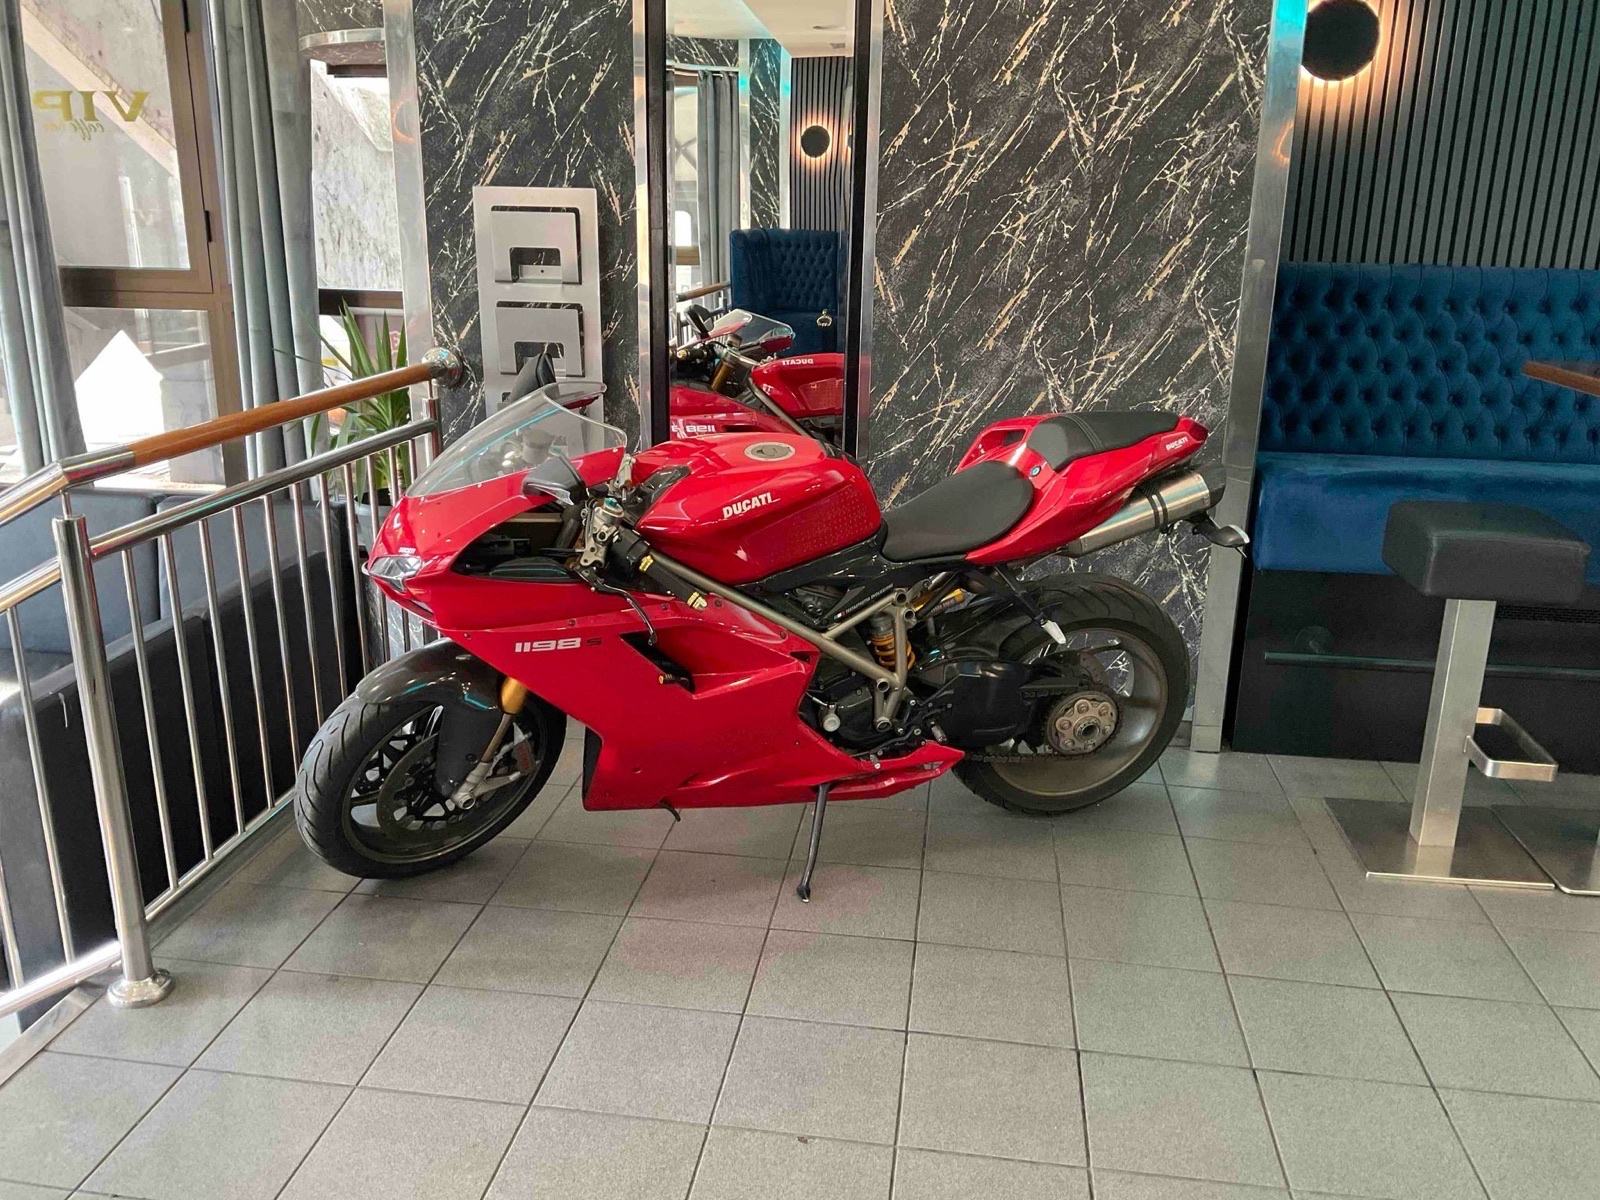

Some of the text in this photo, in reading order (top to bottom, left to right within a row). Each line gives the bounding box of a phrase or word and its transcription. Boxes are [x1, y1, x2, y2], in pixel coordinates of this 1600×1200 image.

[1165, 436, 1188, 451] DUCATI
[722, 492, 774, 520] DUCATI
[514, 637, 581, 653] 1198
